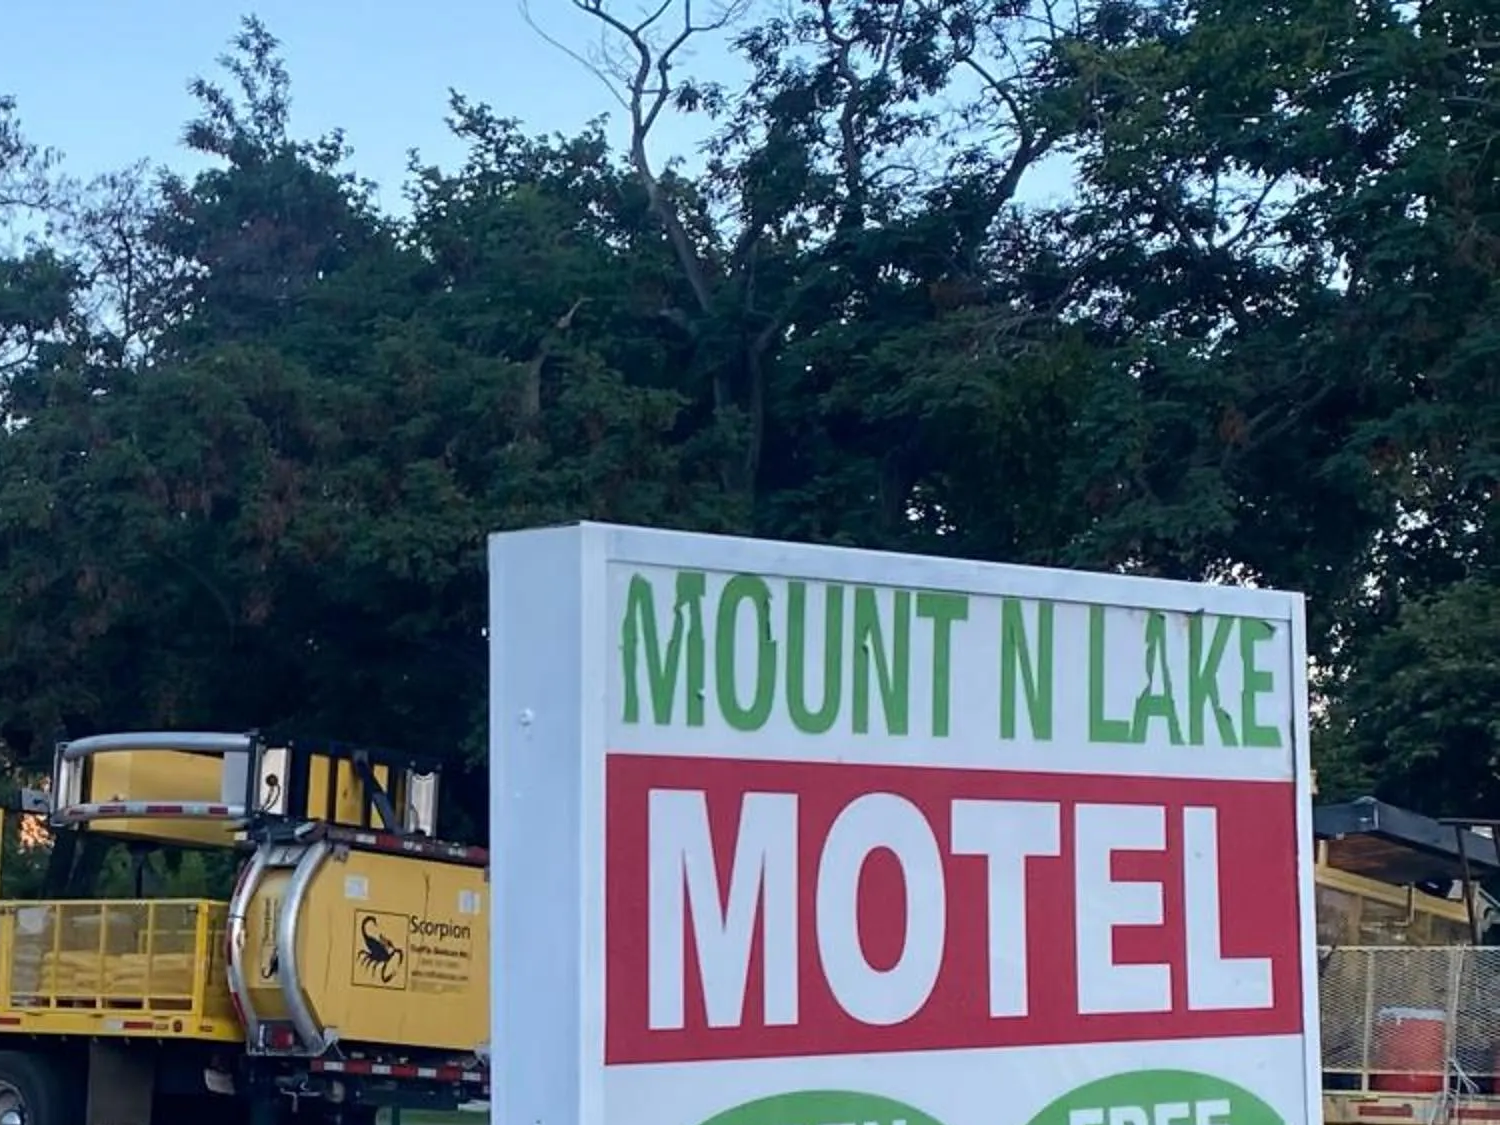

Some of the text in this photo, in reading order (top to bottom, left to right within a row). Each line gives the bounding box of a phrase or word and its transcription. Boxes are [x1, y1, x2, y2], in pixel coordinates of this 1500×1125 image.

[621, 573, 1283, 748] MOUNT N LAKE
[410, 915, 471, 940] Scorpion
[647, 789, 1274, 1030] MOTEL
